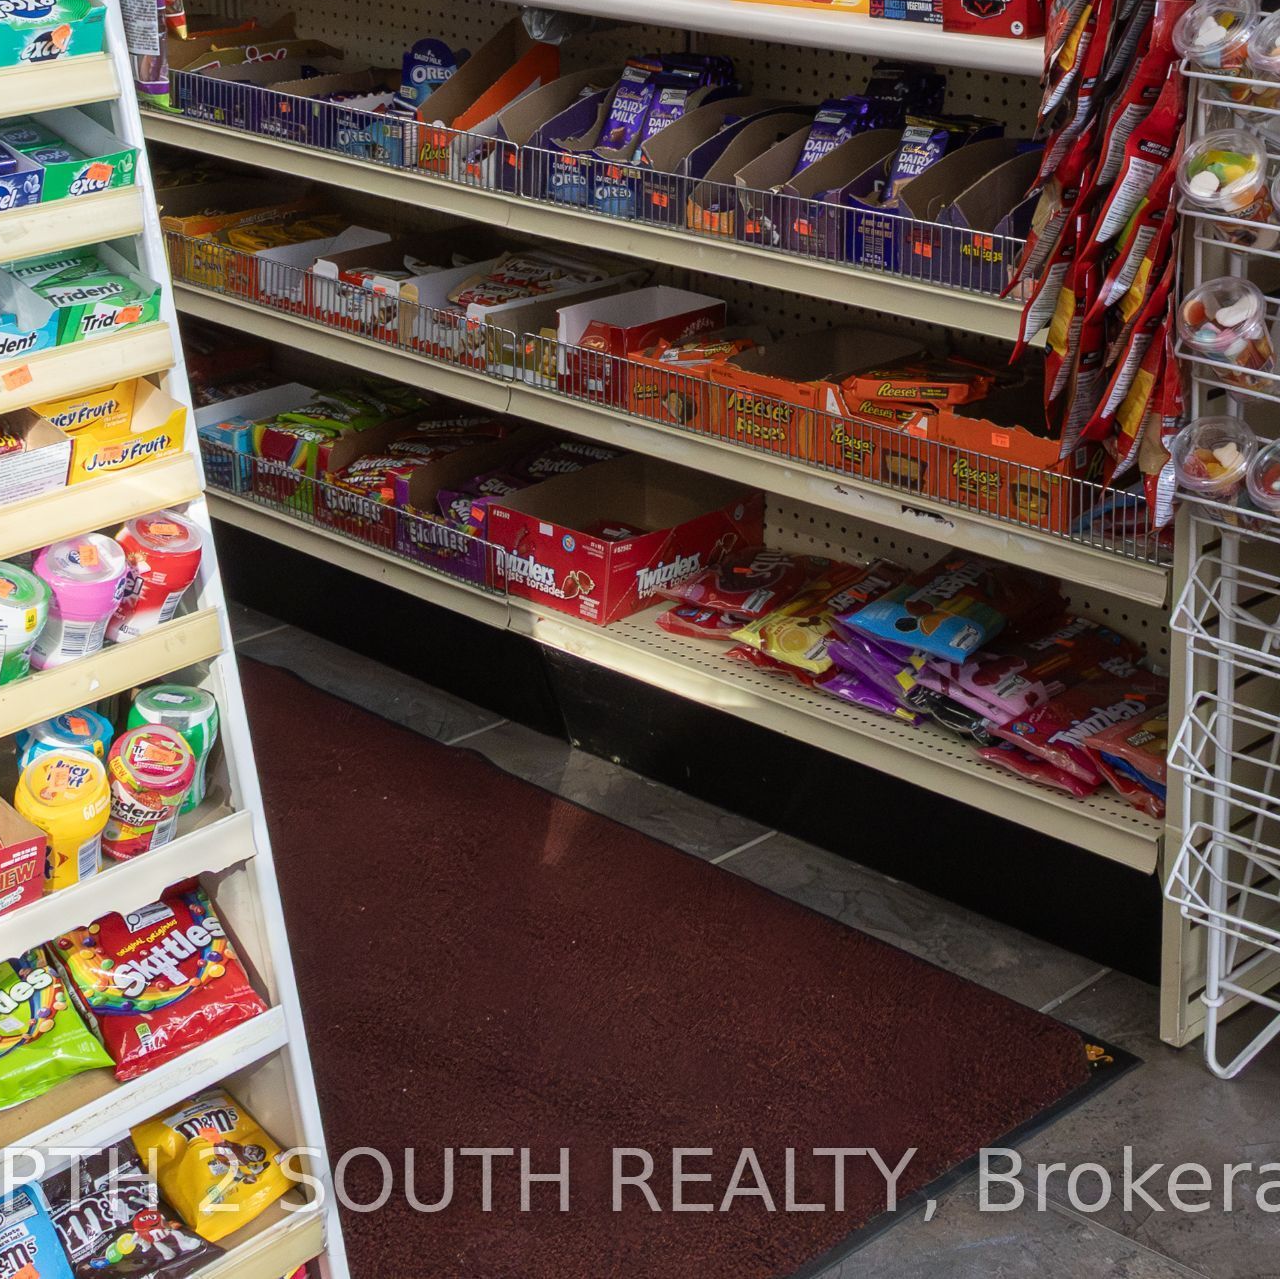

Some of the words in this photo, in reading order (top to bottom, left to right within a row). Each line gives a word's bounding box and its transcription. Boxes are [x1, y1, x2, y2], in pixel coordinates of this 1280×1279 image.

[412, 65, 457, 84] OREO
[613, 97, 649, 115] DAIRY
[610, 107, 638, 125] MILK
[896, 163, 924, 175] MILK
[898, 153, 934, 169] DAIRY
[637, 550, 701, 590] Twizzlers
